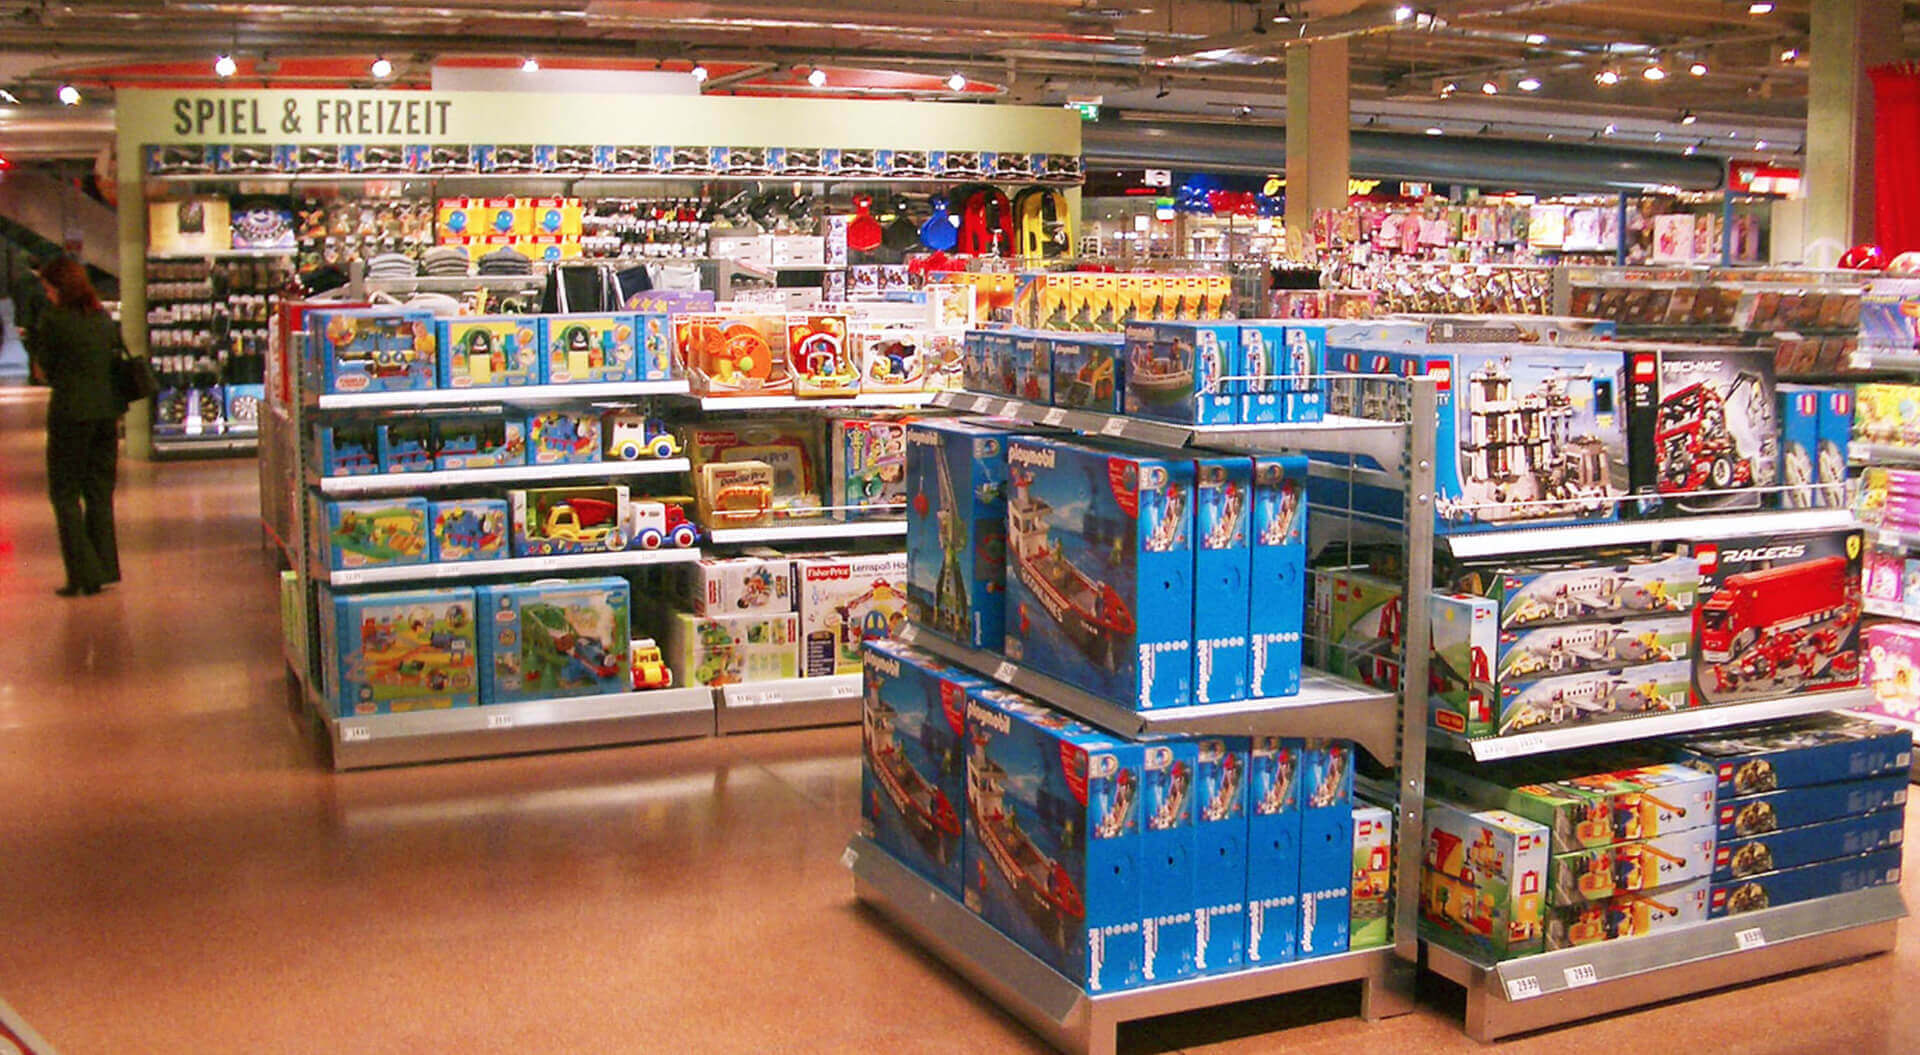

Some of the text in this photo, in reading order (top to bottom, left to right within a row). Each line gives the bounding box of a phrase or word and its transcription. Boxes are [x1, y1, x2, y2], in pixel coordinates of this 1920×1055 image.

[173, 97, 452, 136] SPIEL & FREIZEIT
[1662, 360, 1723, 373] TECHNIC
[1008, 443, 1056, 469] playmobil
[1721, 545, 1806, 563] RACERS
